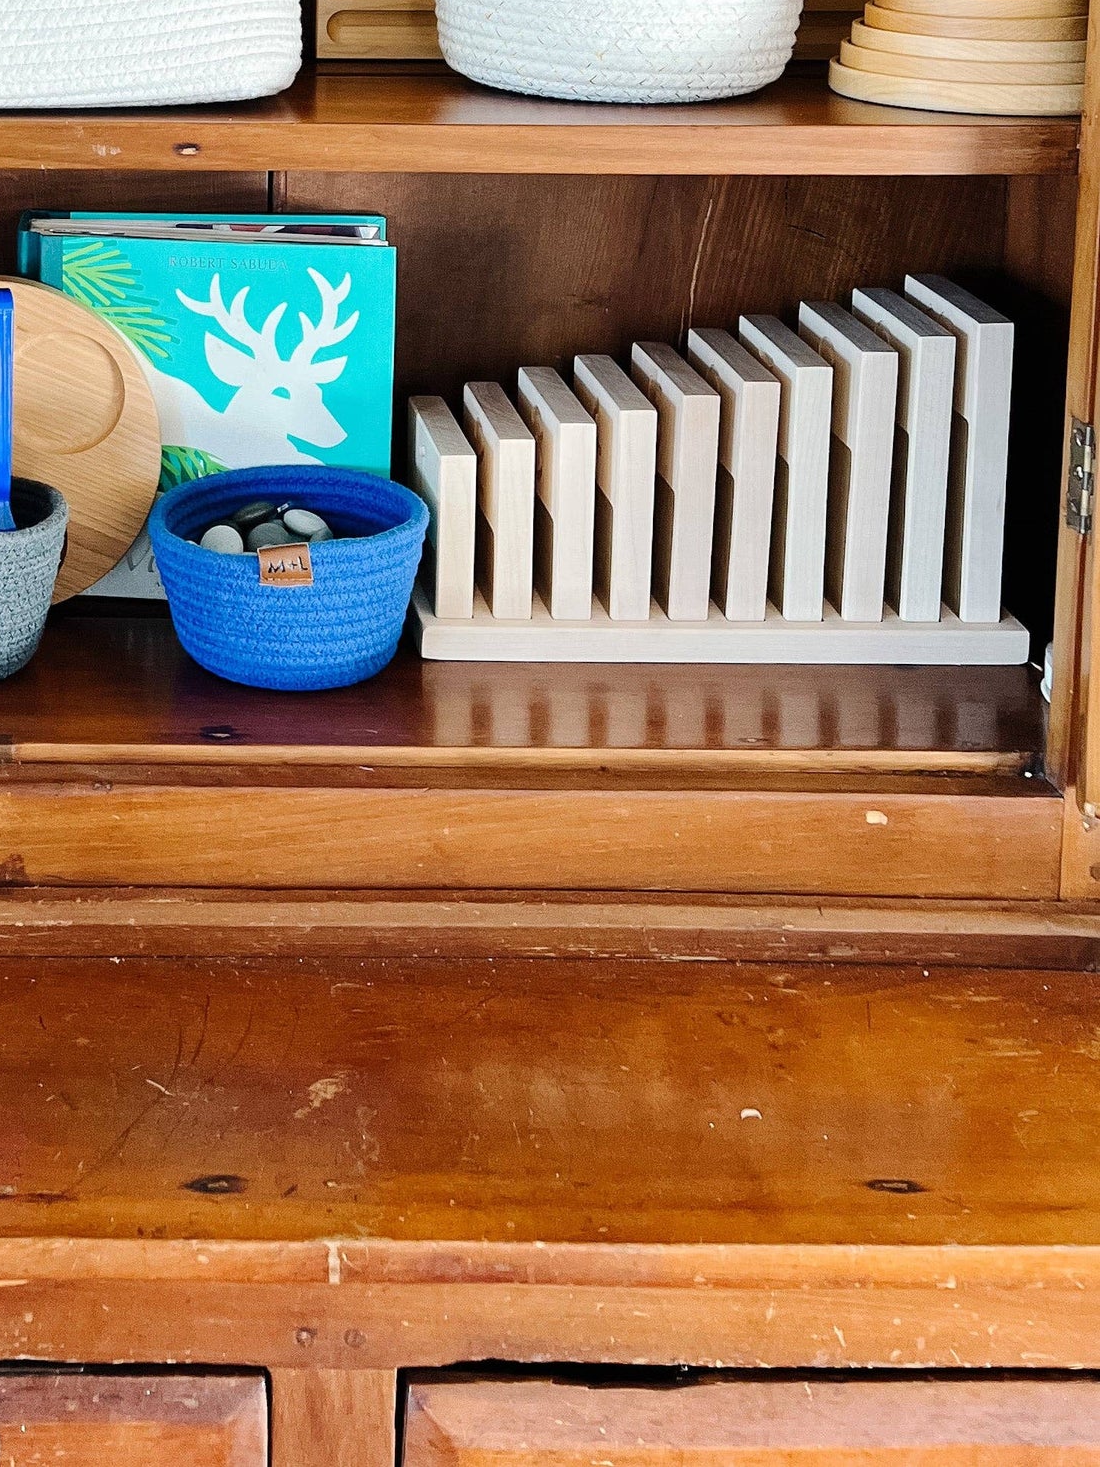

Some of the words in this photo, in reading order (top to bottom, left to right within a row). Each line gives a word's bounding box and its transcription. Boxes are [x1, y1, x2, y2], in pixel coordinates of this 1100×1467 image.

[169, 255, 227, 269] ROBERT
[229, 257, 289, 271] SABUDA
[267, 556, 309, 574] M+L
